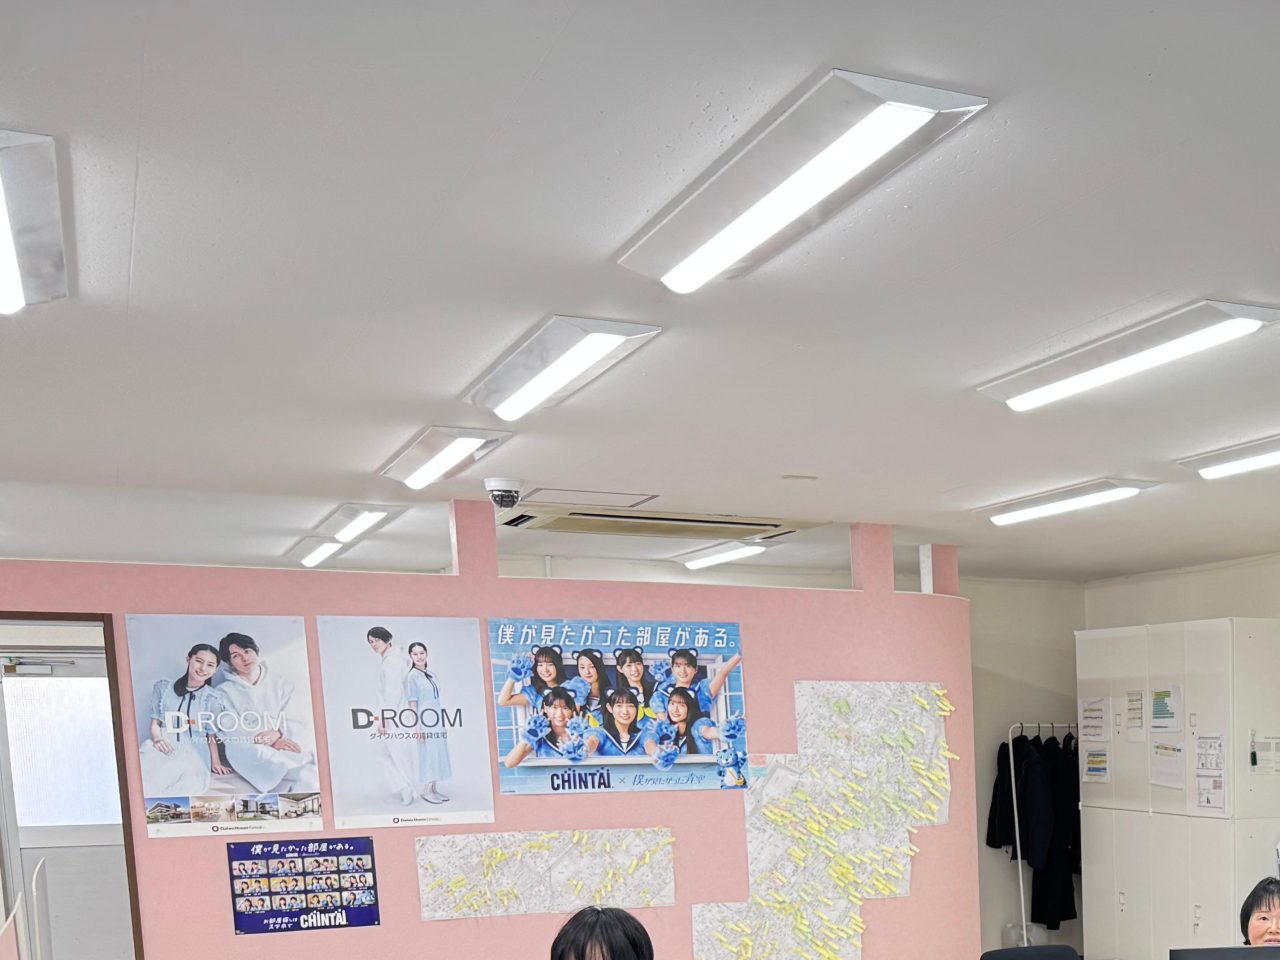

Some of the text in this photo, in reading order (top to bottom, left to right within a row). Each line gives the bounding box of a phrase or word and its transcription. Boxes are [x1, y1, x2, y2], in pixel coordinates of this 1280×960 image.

[497, 623, 736, 648] 僕が見たかった部屋がある。
[550, 767, 614, 791] CHINTAI
[299, 908, 349, 929] CHINTAI
